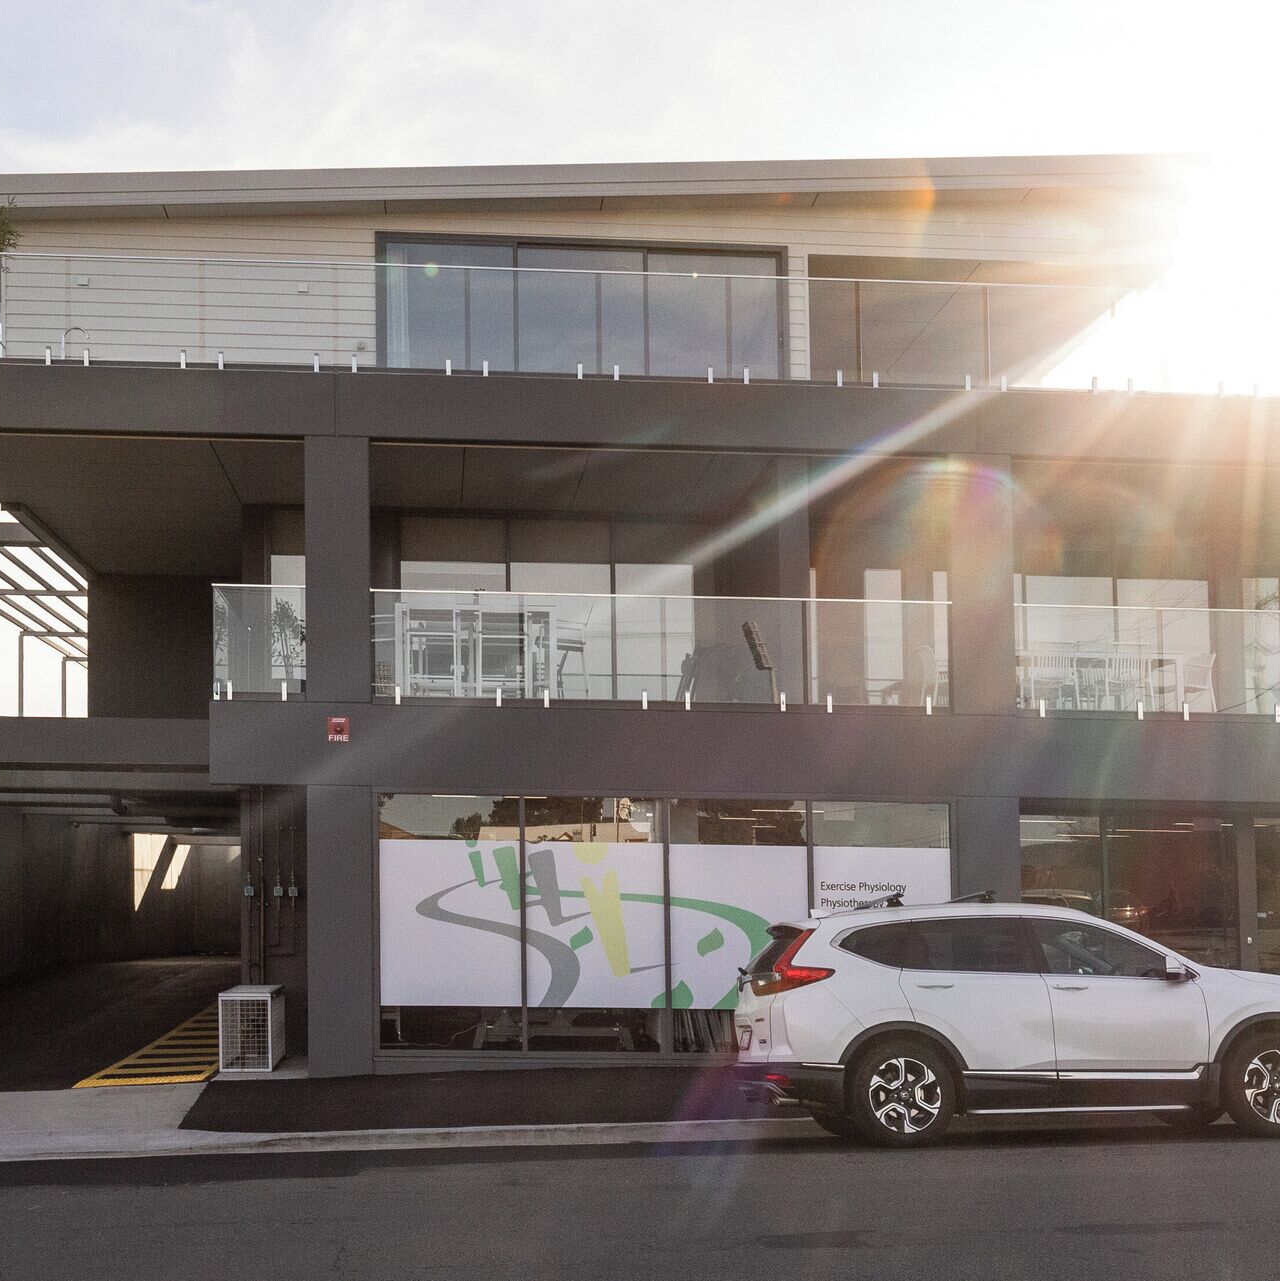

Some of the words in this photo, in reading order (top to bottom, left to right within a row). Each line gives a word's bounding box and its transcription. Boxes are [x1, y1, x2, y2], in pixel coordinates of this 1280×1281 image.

[328, 734, 349, 742] FIRE
[820, 881, 856, 892] Exercise
[859, 882, 907, 894] Physiology
